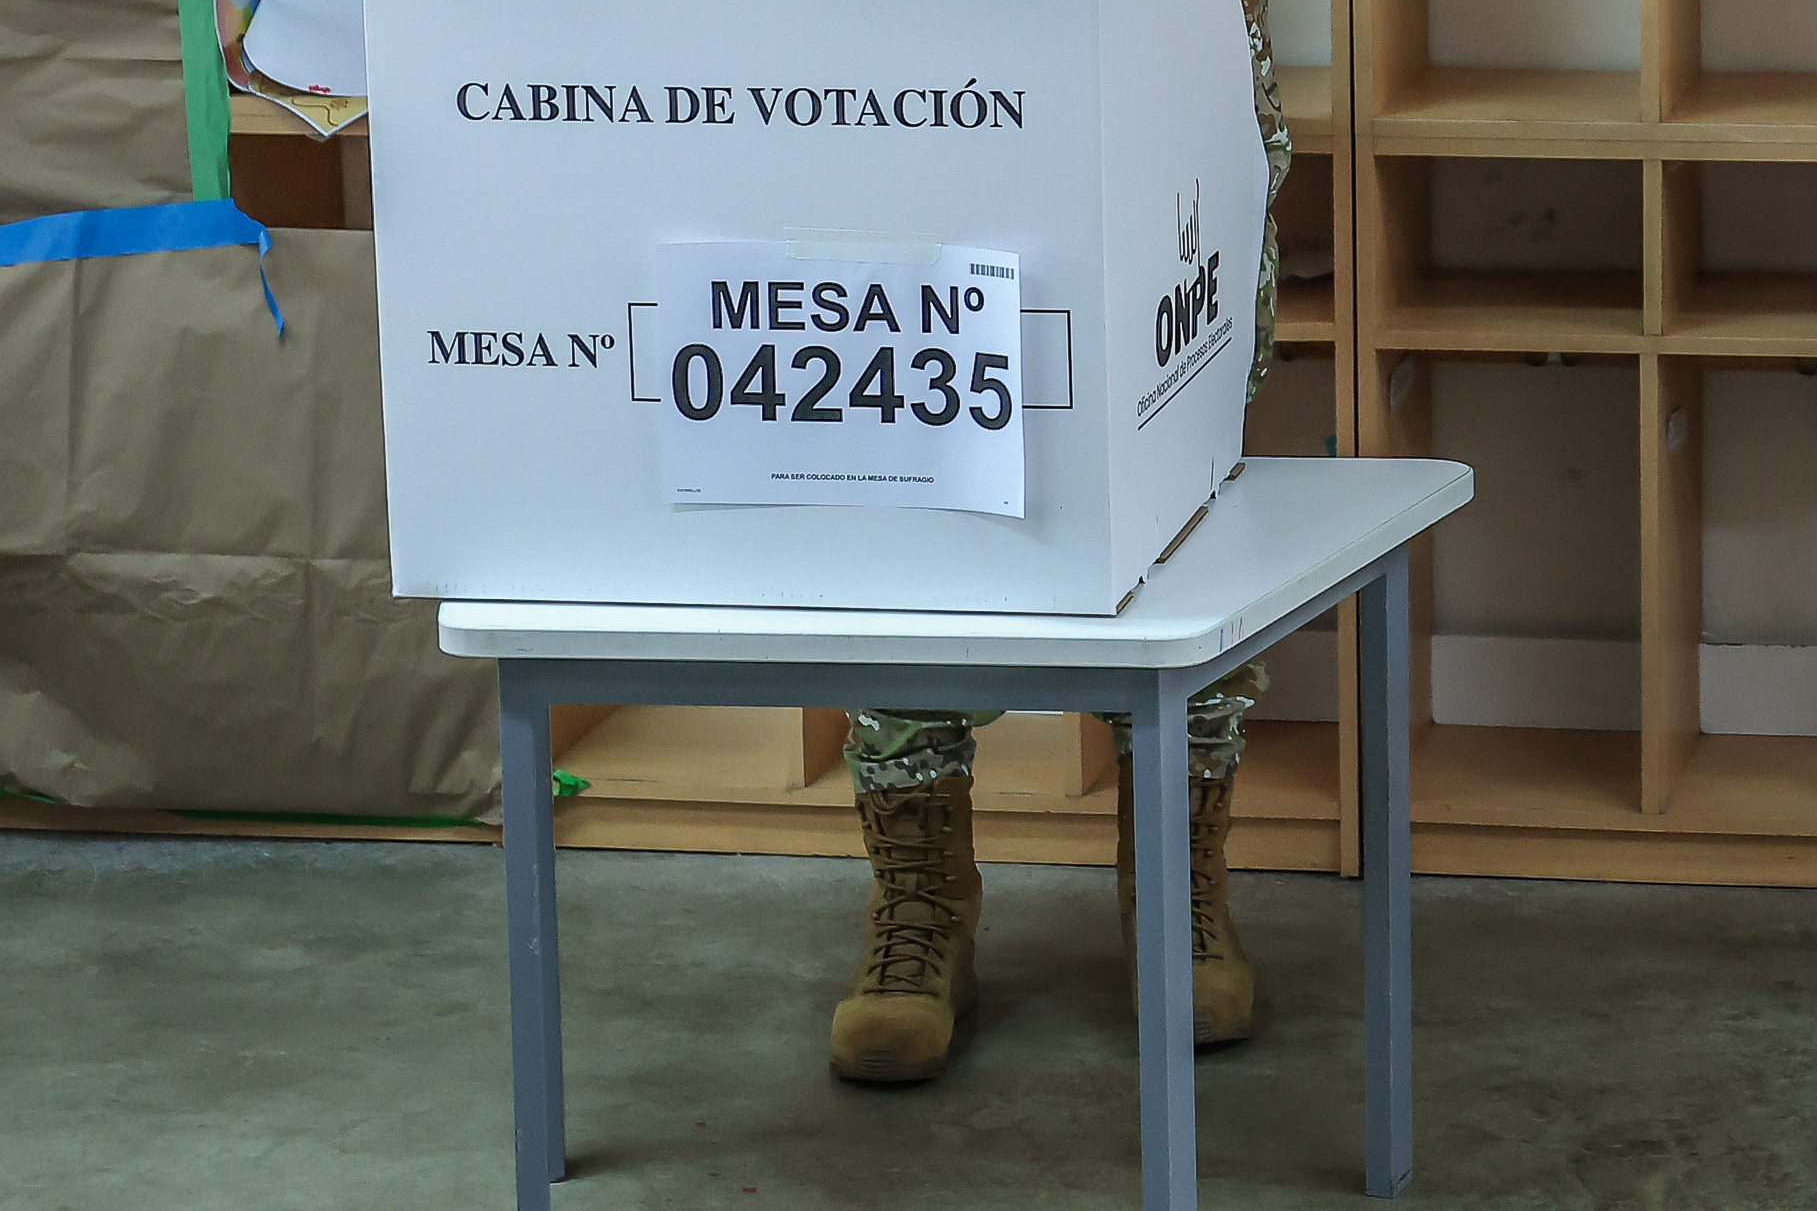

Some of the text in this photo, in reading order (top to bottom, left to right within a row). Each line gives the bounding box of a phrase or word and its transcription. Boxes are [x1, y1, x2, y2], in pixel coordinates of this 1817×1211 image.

[456, 77, 1026, 129] CABINA DE VOTACIÓN
[711, 281, 902, 333] MESA
[1155, 250, 1220, 368] ONPE
[427, 330, 559, 367] MESA
[671, 343, 1013, 431] 042435
[899, 476, 934, 484] SUFRAGIO
